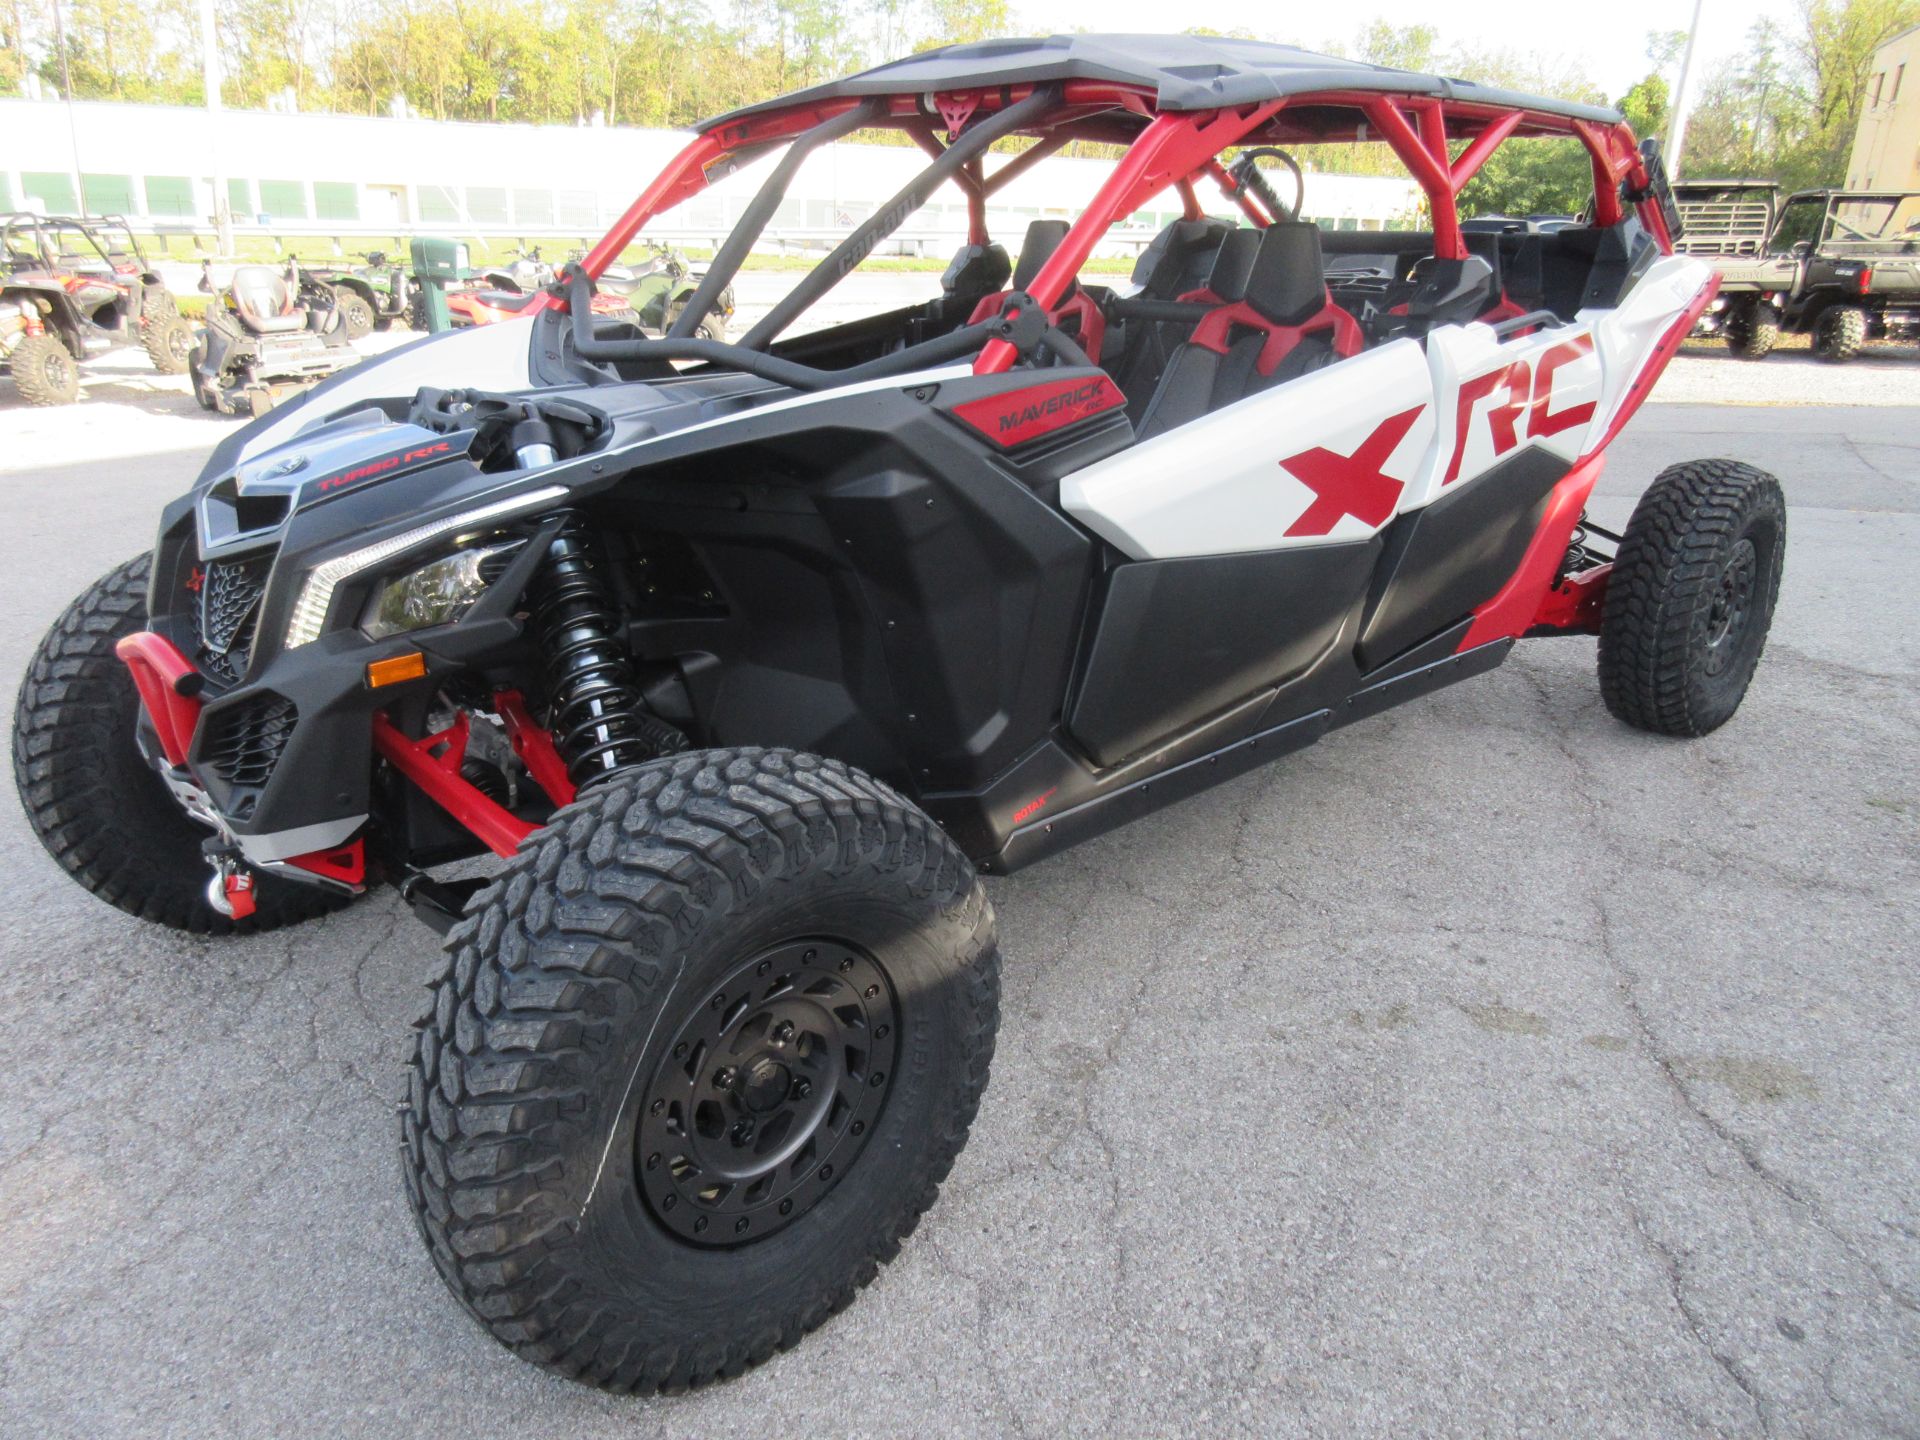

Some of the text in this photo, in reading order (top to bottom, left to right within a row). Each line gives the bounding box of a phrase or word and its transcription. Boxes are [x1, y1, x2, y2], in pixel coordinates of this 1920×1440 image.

[1722, 269, 1763, 280] wasaki
[999, 379, 1105, 433] MAVERICK
[317, 442, 450, 491] TURBO RR
[1013, 796, 1046, 824] ROTAX
